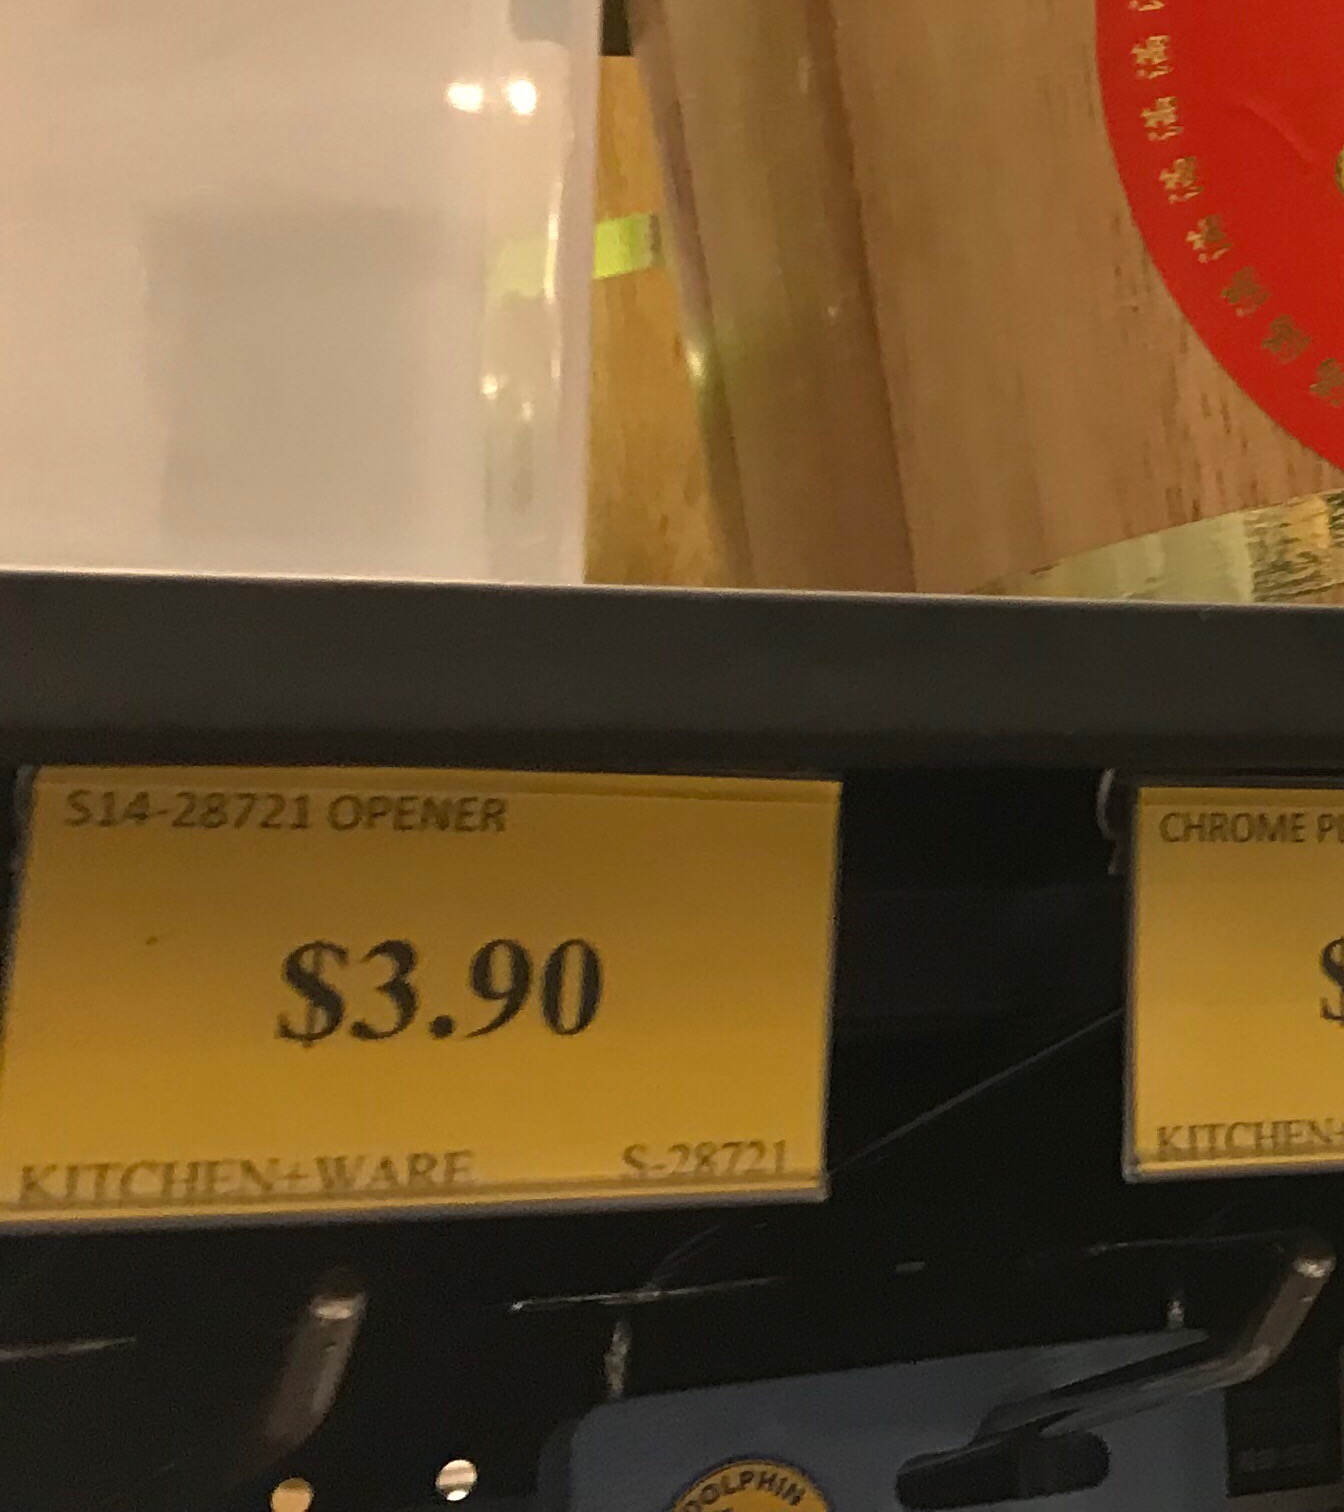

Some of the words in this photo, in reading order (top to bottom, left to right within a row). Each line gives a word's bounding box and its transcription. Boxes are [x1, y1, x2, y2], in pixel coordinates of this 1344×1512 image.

[63, 789, 310, 831] S14-28721
[328, 792, 507, 834] OPENER
[1159, 811, 1306, 843] CHROME
[276, 937, 603, 1048] $3.90
[17, 1150, 476, 1205] KITCHEN+WARE
[621, 1140, 787, 1180] S-28721
